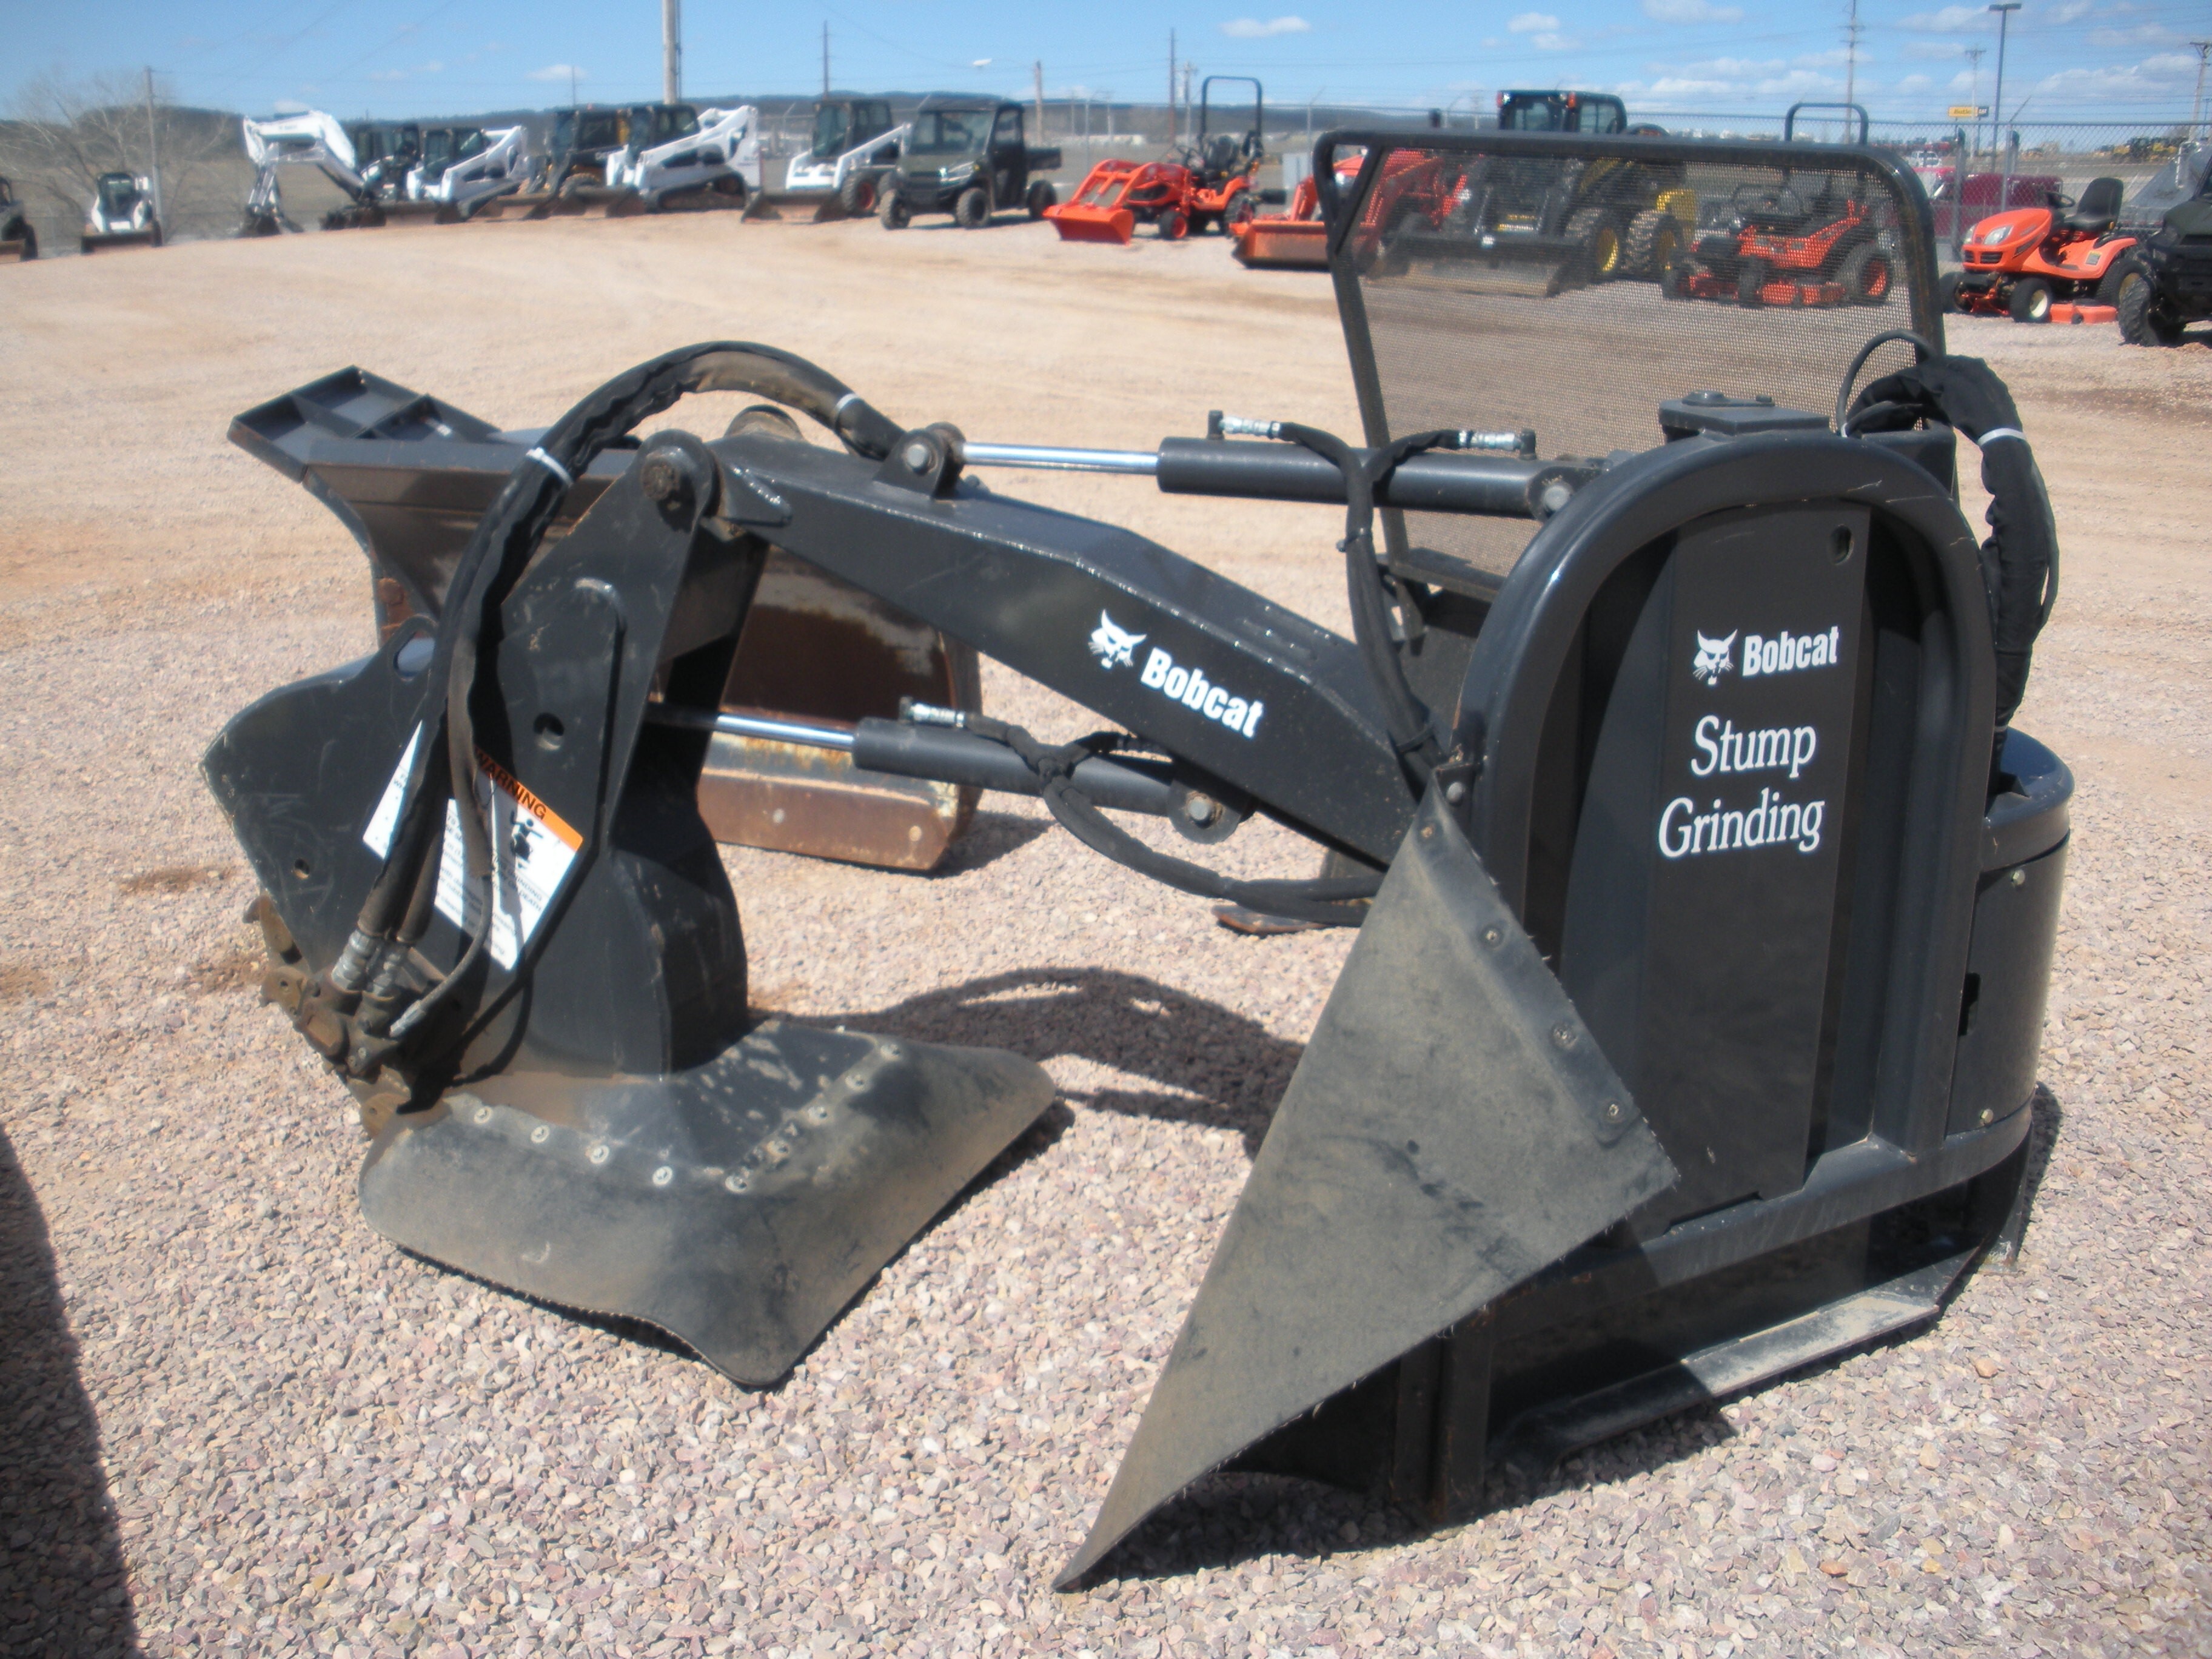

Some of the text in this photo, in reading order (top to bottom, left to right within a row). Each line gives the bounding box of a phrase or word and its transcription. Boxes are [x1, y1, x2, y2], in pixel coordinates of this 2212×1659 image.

[1741, 625, 1839, 677] Bobcat
[1140, 646, 1265, 739] Bobcat
[474, 745, 547, 820] WARNING
[1691, 715, 1817, 779] Stump
[1658, 786, 1825, 859] Grinding
